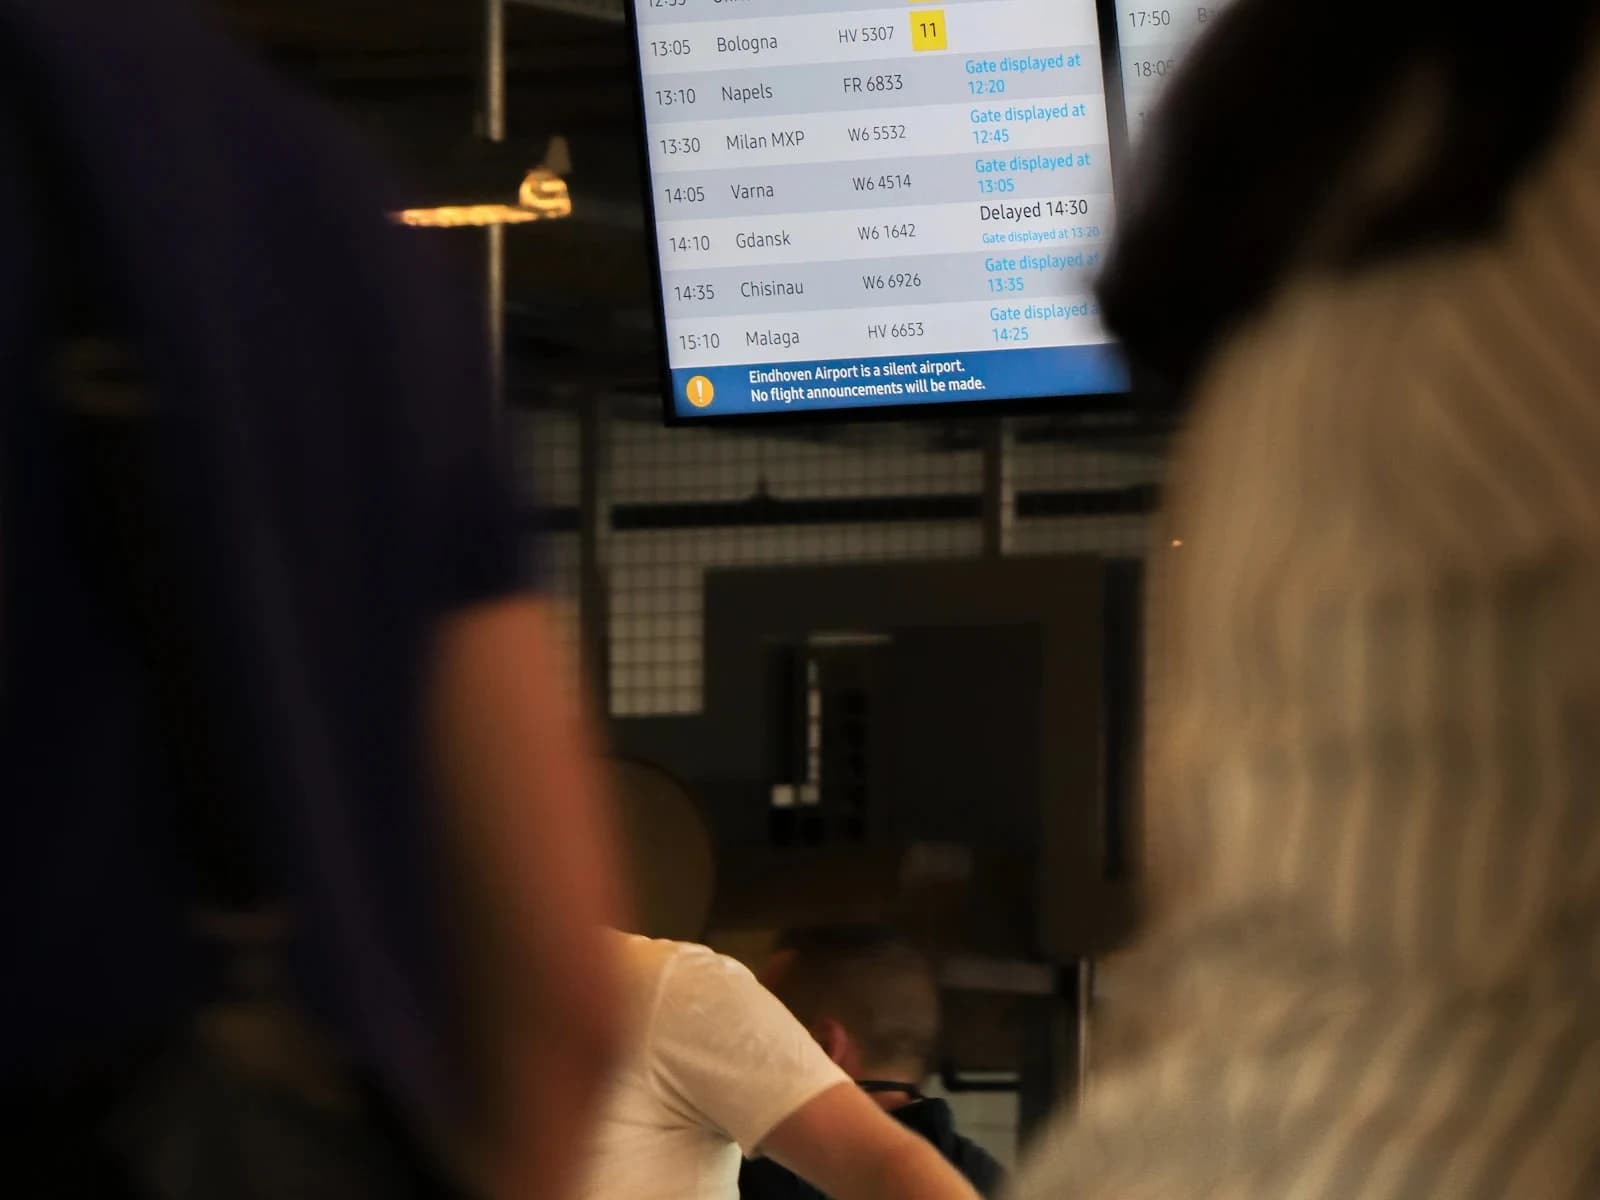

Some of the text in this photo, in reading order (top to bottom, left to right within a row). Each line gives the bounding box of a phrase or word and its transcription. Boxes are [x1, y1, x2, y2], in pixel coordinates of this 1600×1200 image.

[1129, 10, 1170, 27] 17:50
[651, 22, 936, 56] 13:05 Bologna HV 5307 11
[965, 54, 1081, 74] Gate displayed at
[656, 75, 903, 105] 13:10 Napels FR 6833
[968, 80, 1004, 94] 12:20
[970, 104, 1085, 123] Gate displayed at
[660, 125, 905, 154] 13:30 Milan MXP W6 5532
[973, 129, 1009, 144] 12:45
[975, 153, 1073, 173] Gate displayed
[665, 174, 912, 203] 14:05 Varna W6 4514
[977, 178, 1015, 193] 13:05
[670, 200, 1087, 252] 14:10 Gdansk W6 1642 Delayed 14:30
[675, 273, 921, 300] 14:35 Chisinau W6 6926
[988, 278, 1024, 291] 13:35
[680, 322, 923, 349] 15:10 Malaga HV 6653
[993, 327, 1029, 342] 14:25
[749, 359, 966, 383] Eindhoven Airport is a silent airport.
[751, 376, 986, 404] No flight announcements will be made.
